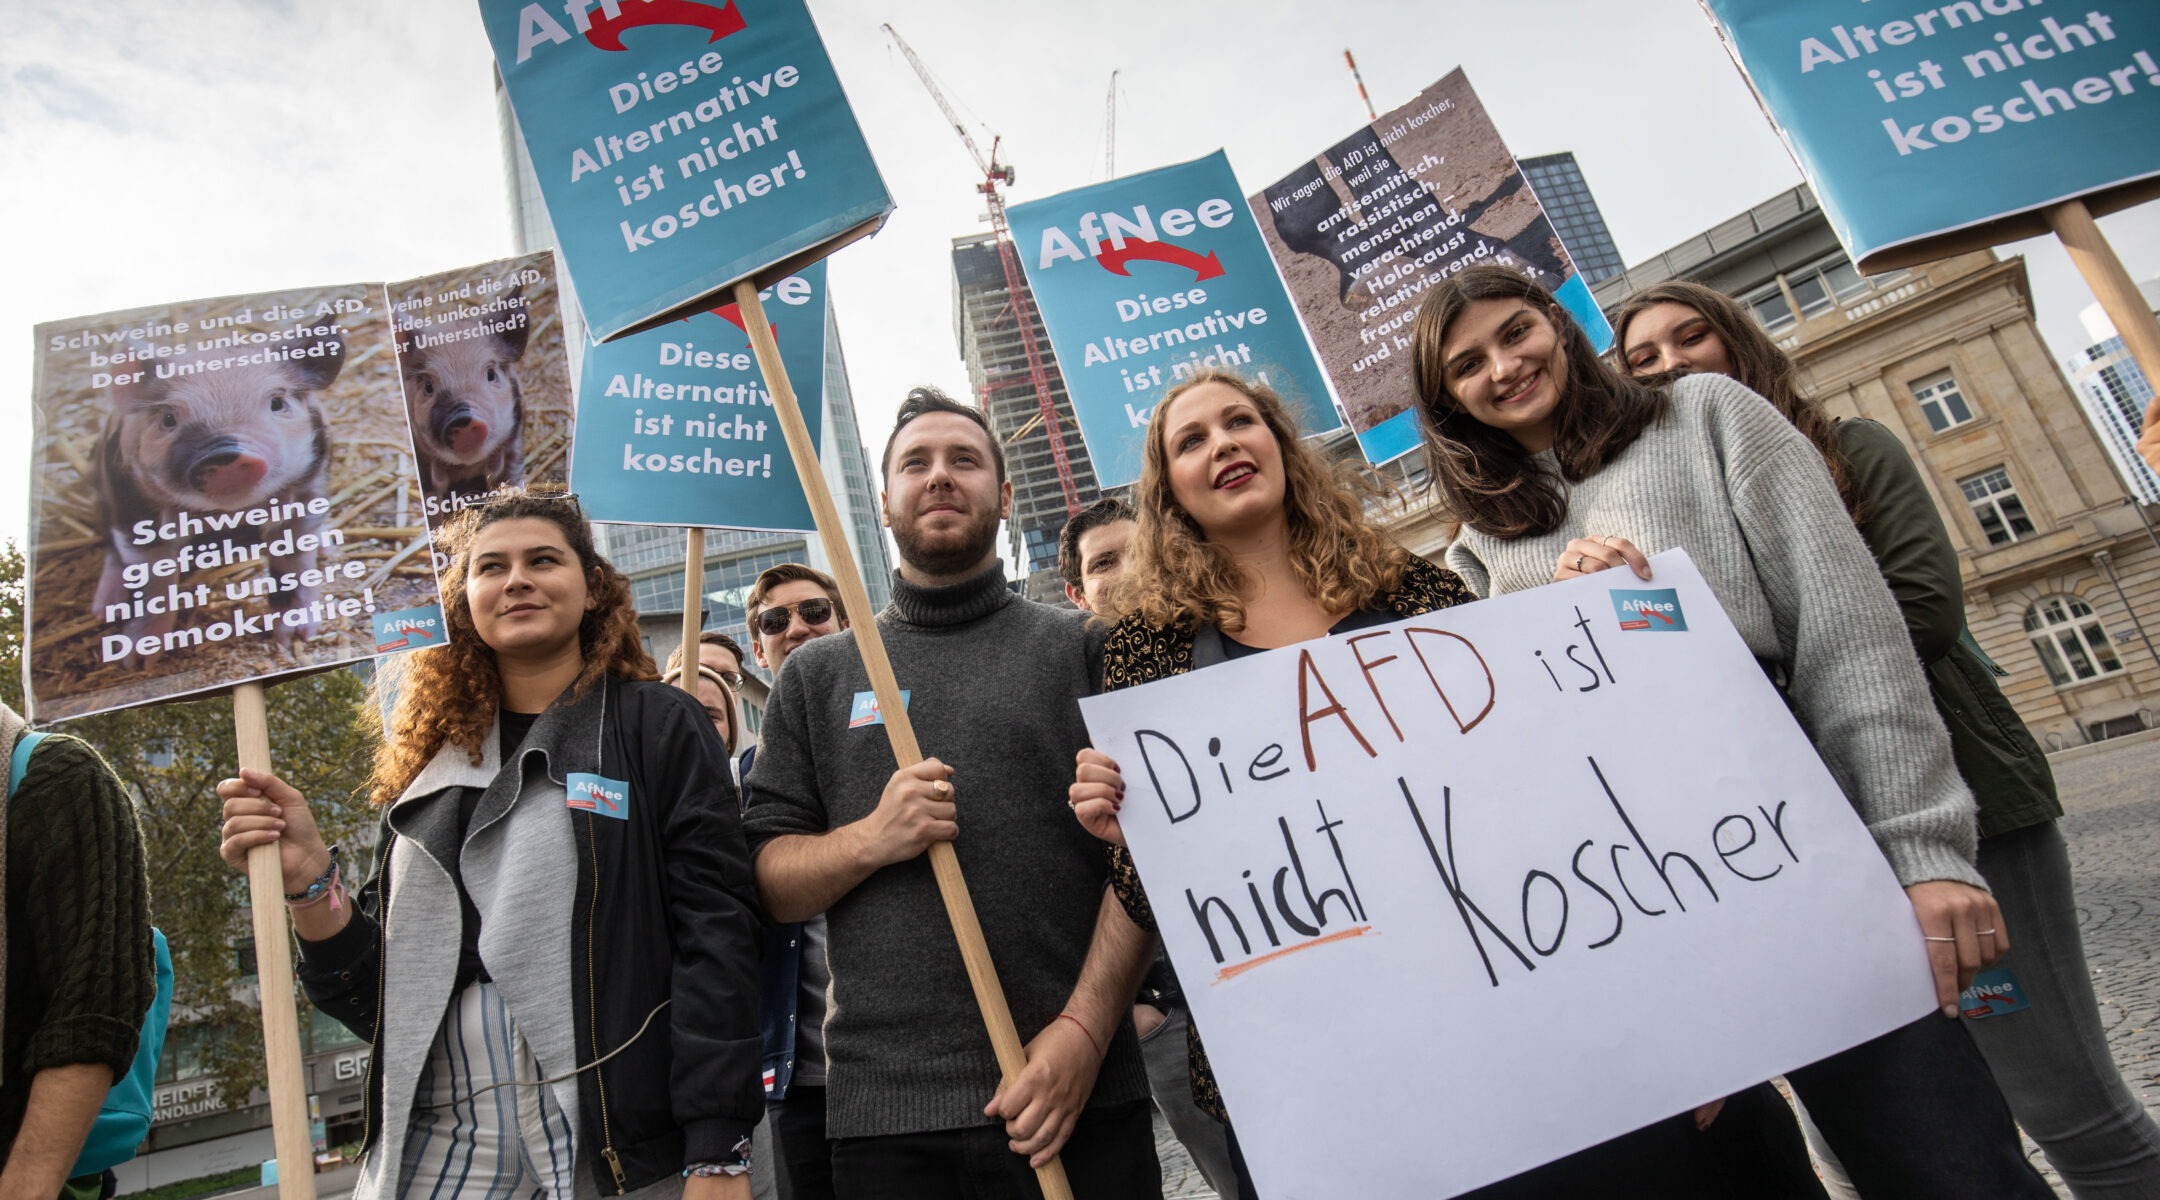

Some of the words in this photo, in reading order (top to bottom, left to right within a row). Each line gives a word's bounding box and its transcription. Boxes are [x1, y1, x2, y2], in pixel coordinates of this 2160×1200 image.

[1800, 0, 2043, 74] Alterna
[1867, 60, 1947, 104] ist
[1962, 11, 2117, 79] nicht
[608, 52, 724, 114] Diese
[1881, 50, 2160, 157] koscher!
[570, 64, 800, 183] Alternative
[614, 164, 665, 206] ist
[678, 114, 779, 180] nicht
[1270, 196, 1292, 214] Wir
[1292, 177, 1325, 202] sagen
[1324, 165, 1343, 183] die
[1342, 150, 1364, 171] AfD
[1363, 141, 1380, 158] ist
[1379, 124, 1408, 148] nicht
[1407, 98, 1456, 131] koscher,
[1348, 168, 1373, 189] weil
[1374, 158, 1390, 174] sie
[620, 150, 808, 253] koscher!
[1317, 153, 1446, 233] antisemitisch,
[1337, 180, 1442, 243] rassistisch,
[1038, 197, 1235, 270] AfNee
[1340, 203, 1438, 264] menschen
[1348, 208, 1467, 281] verachtend,
[1366, 231, 1466, 294] Holocaust
[437, 294, 532, 325] unkoscher.
[438, 283, 471, 304] und
[476, 278, 503, 295] die
[508, 269, 547, 290] AfD,
[1115, 285, 1208, 323] Diese
[1359, 239, 1496, 322] relativierend,
[49, 320, 190, 353] Schweine
[199, 309, 252, 333] und
[262, 304, 306, 324] die
[314, 298, 374, 318] AfD,
[89, 341, 188, 368] beides
[197, 322, 350, 352] unkoscher.
[414, 313, 528, 351] Unterschied?
[1083, 305, 1268, 368] Alternative
[91, 368, 146, 389] Der
[155, 341, 341, 380] Unterschied?
[658, 342, 752, 372] Diese
[1119, 365, 1162, 393] ist
[1171, 342, 1252, 381] nicht
[1352, 342, 1392, 373] und
[604, 374, 785, 408] Alternativ
[633, 410, 673, 437] ist
[684, 414, 768, 443] nicht
[622, 443, 772, 479] koscher!
[131, 496, 331, 547] Schweine
[121, 526, 344, 590] gefährden
[105, 585, 211, 624] nicht
[225, 560, 367, 600] unsere
[1623, 599, 1675, 612] AfNee
[100, 588, 377, 664] Demokratie!
[383, 618, 436, 634] AfNee
[1133, 727, 1291, 825] Die
[1296, 626, 1497, 773] AFD
[1532, 605, 1617, 694] ist
[575, 781, 623, 801] AfNee
[1184, 799, 1370, 965] nicht
[1396, 755, 1803, 989] Koscher
[1961, 982, 2014, 1000] AfNee
